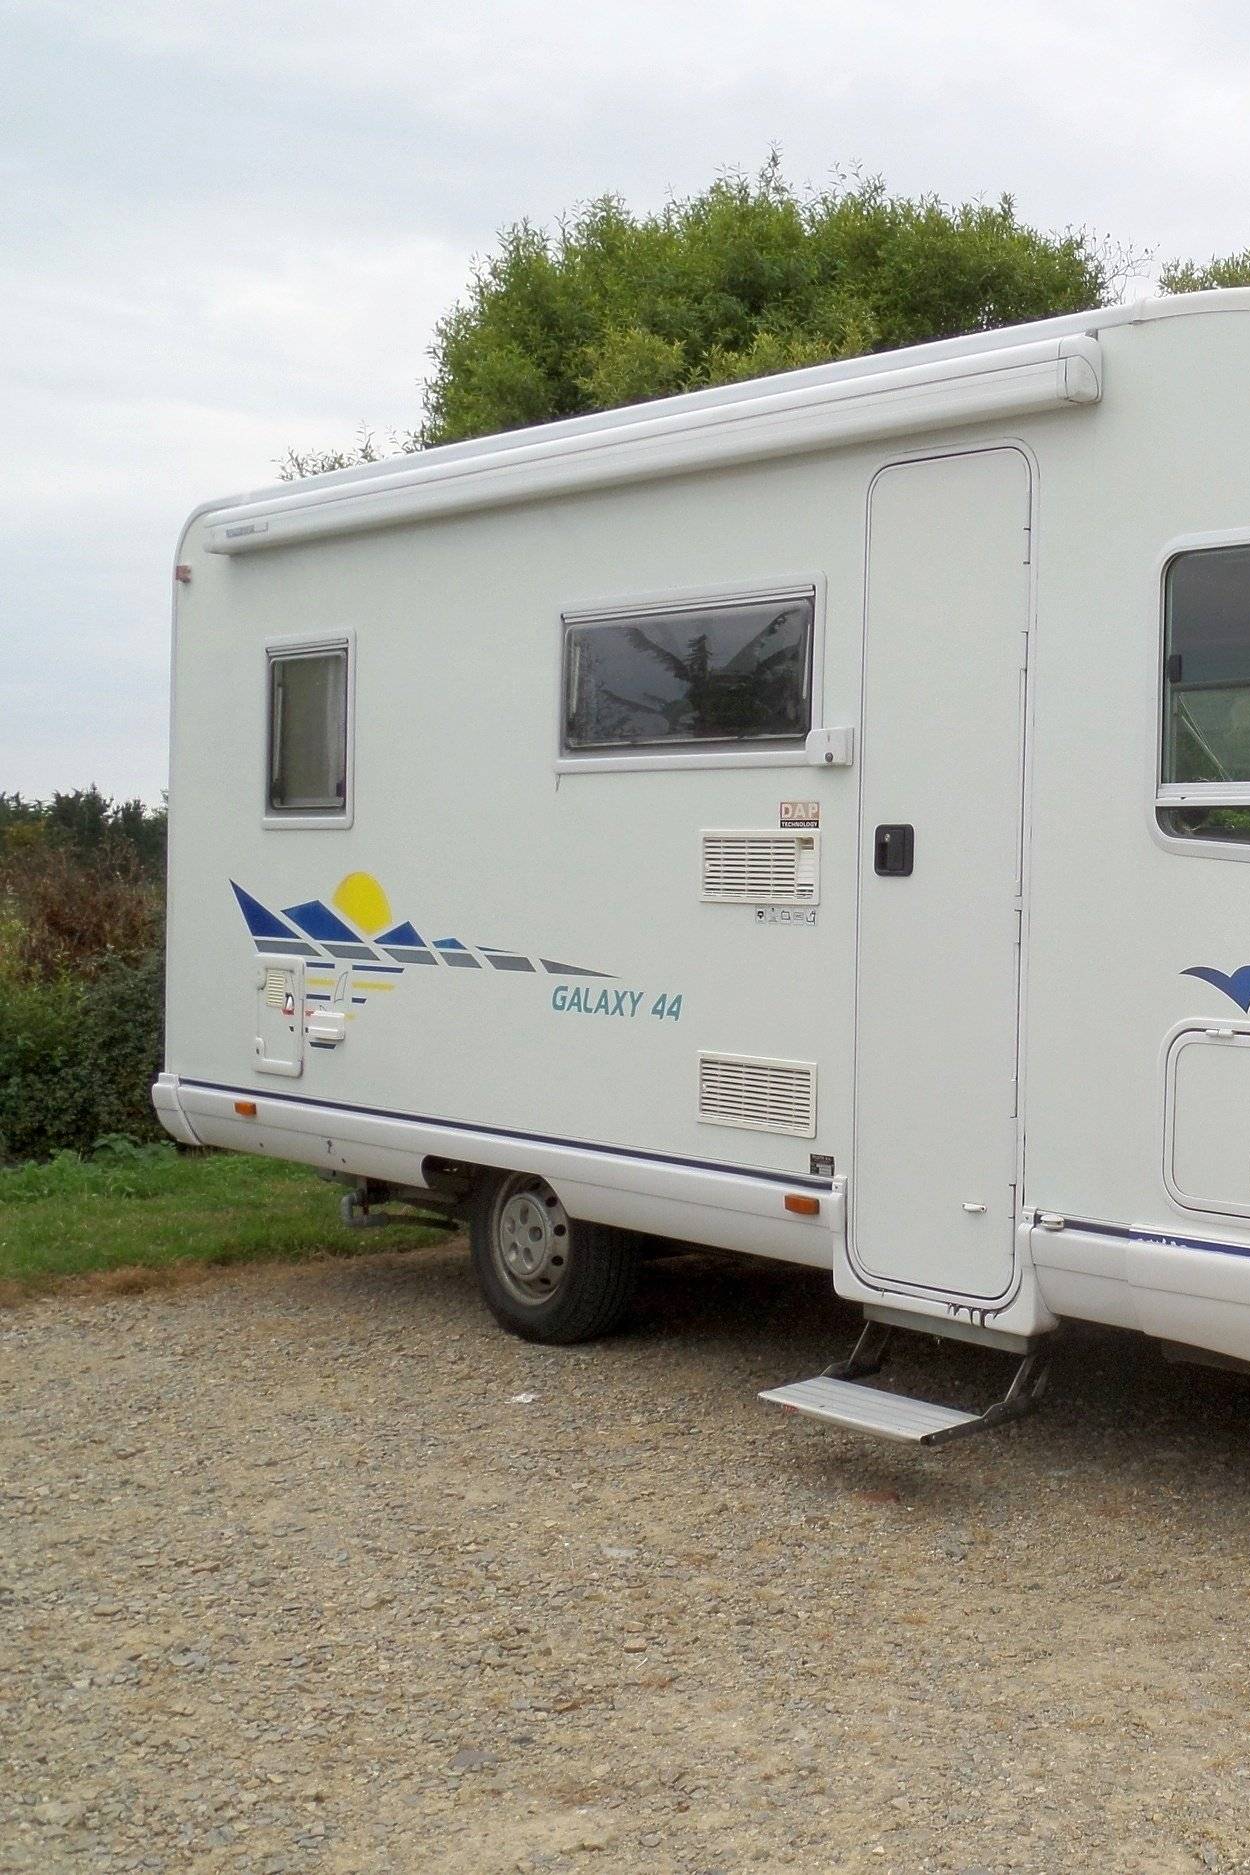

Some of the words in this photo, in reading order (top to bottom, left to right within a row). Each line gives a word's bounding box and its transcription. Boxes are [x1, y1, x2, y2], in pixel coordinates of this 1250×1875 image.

[781, 803, 818, 819] DAP
[551, 985, 644, 1018] GALAXY
[650, 993, 683, 1021] 44
